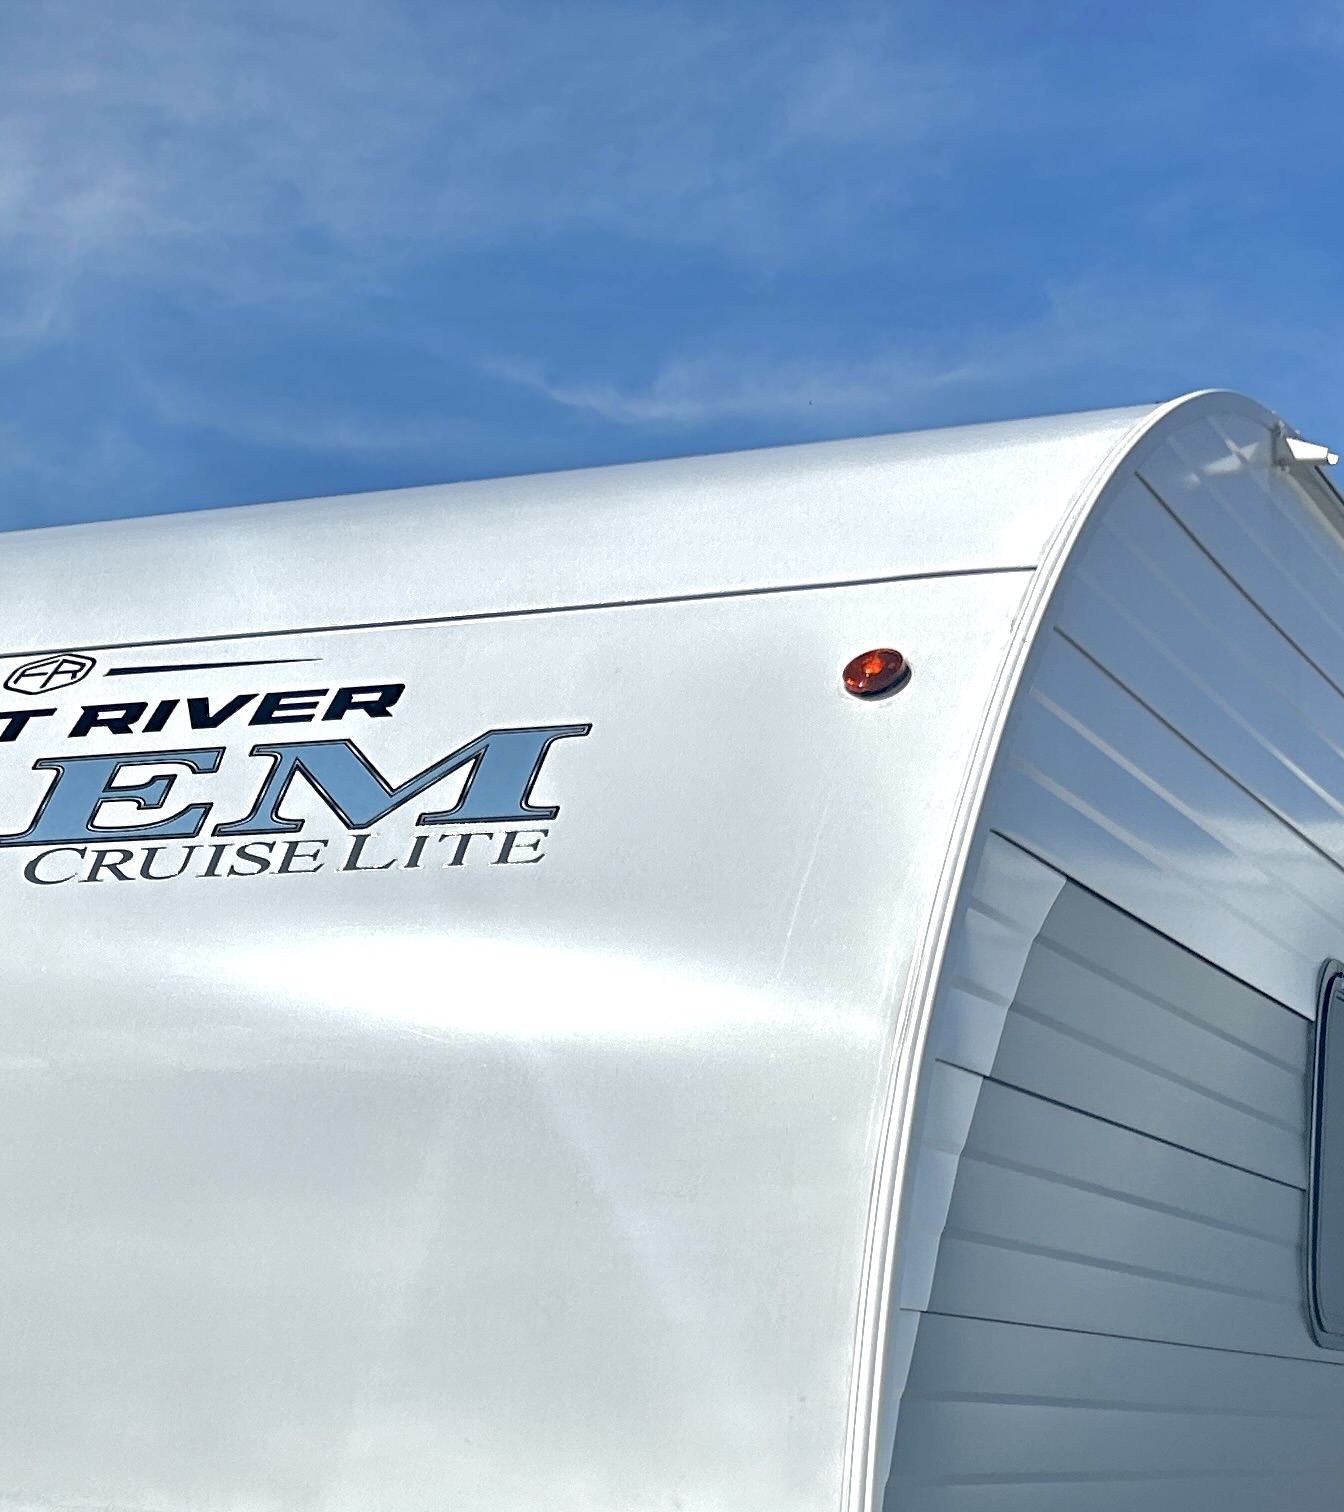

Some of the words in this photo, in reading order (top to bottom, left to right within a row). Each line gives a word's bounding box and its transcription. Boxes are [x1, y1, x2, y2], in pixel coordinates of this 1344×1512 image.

[67, 684, 405, 738] RIVER
[23, 838, 329, 886] CRUISE
[336, 828, 551, 873] LITE
